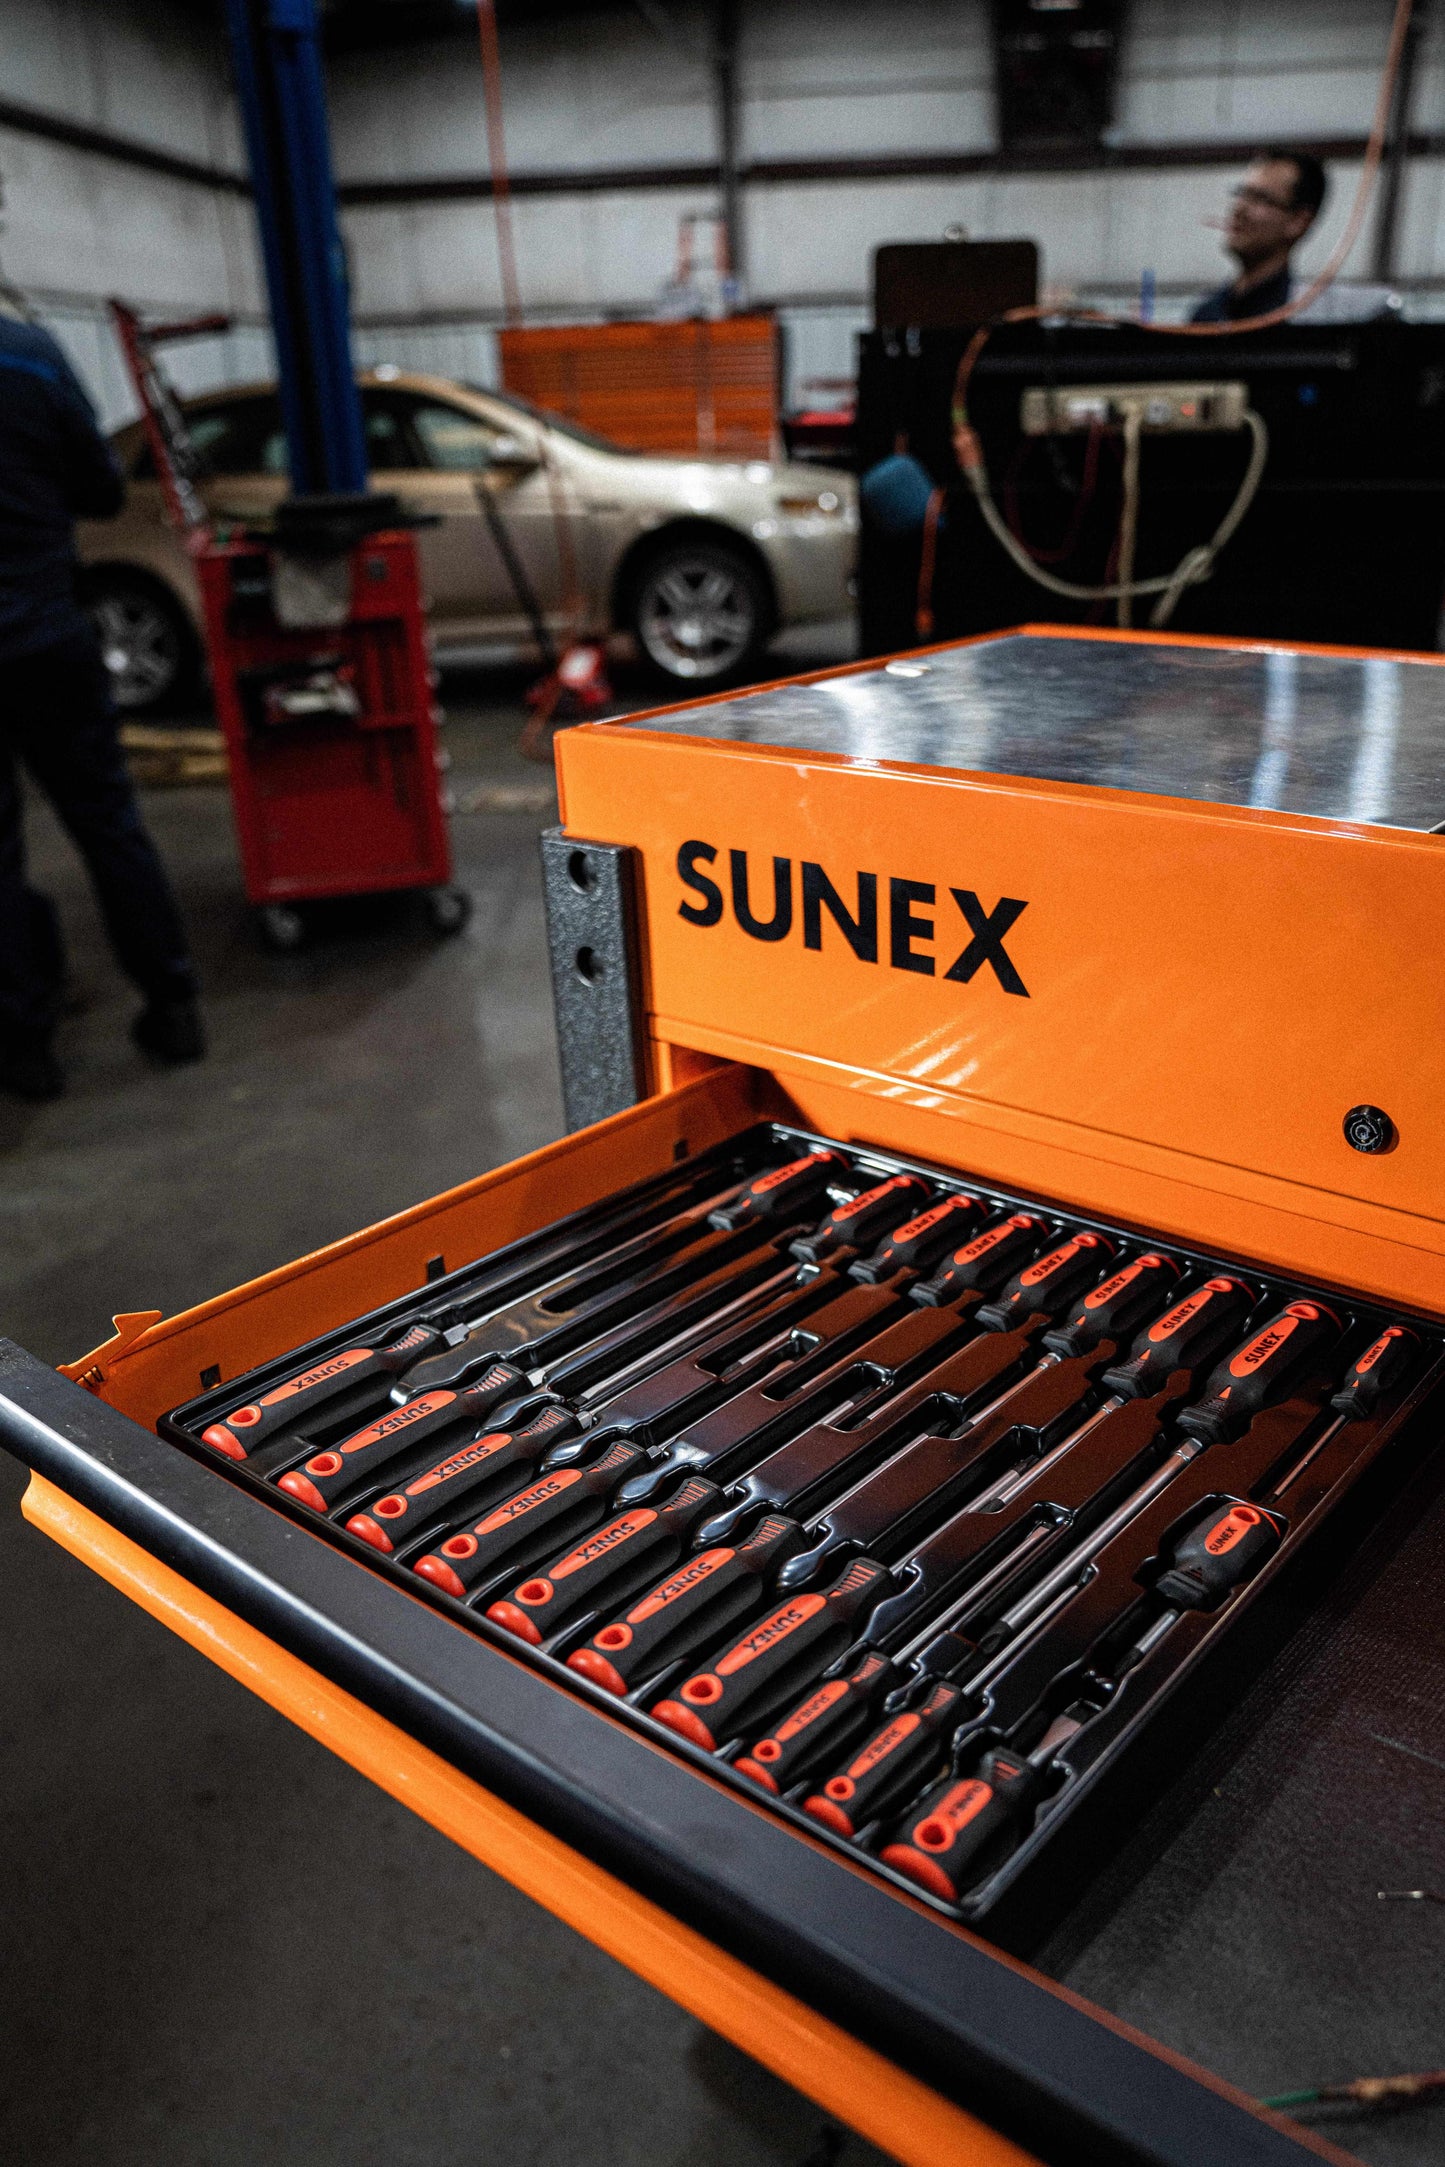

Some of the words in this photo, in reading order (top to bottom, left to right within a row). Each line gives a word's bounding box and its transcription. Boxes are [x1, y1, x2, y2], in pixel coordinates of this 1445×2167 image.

[677, 839, 1031, 999] SUNEX
[1162, 1301, 1199, 1331] SUNEX
[1244, 1331, 1286, 1365] SUNEX
[1362, 1344, 1383, 1365] SUNEX
[291, 1360, 350, 1390] SUNEX
[371, 1402, 433, 1436] SUNEX
[432, 1445, 491, 1480] SUNEX
[502, 1480, 562, 1518] SUNEX
[575, 1521, 635, 1560] SUNEX
[1209, 1525, 1239, 1552] SUNEX
[654, 1562, 713, 1602] SUNEX
[742, 1608, 803, 1653] SUNEX
